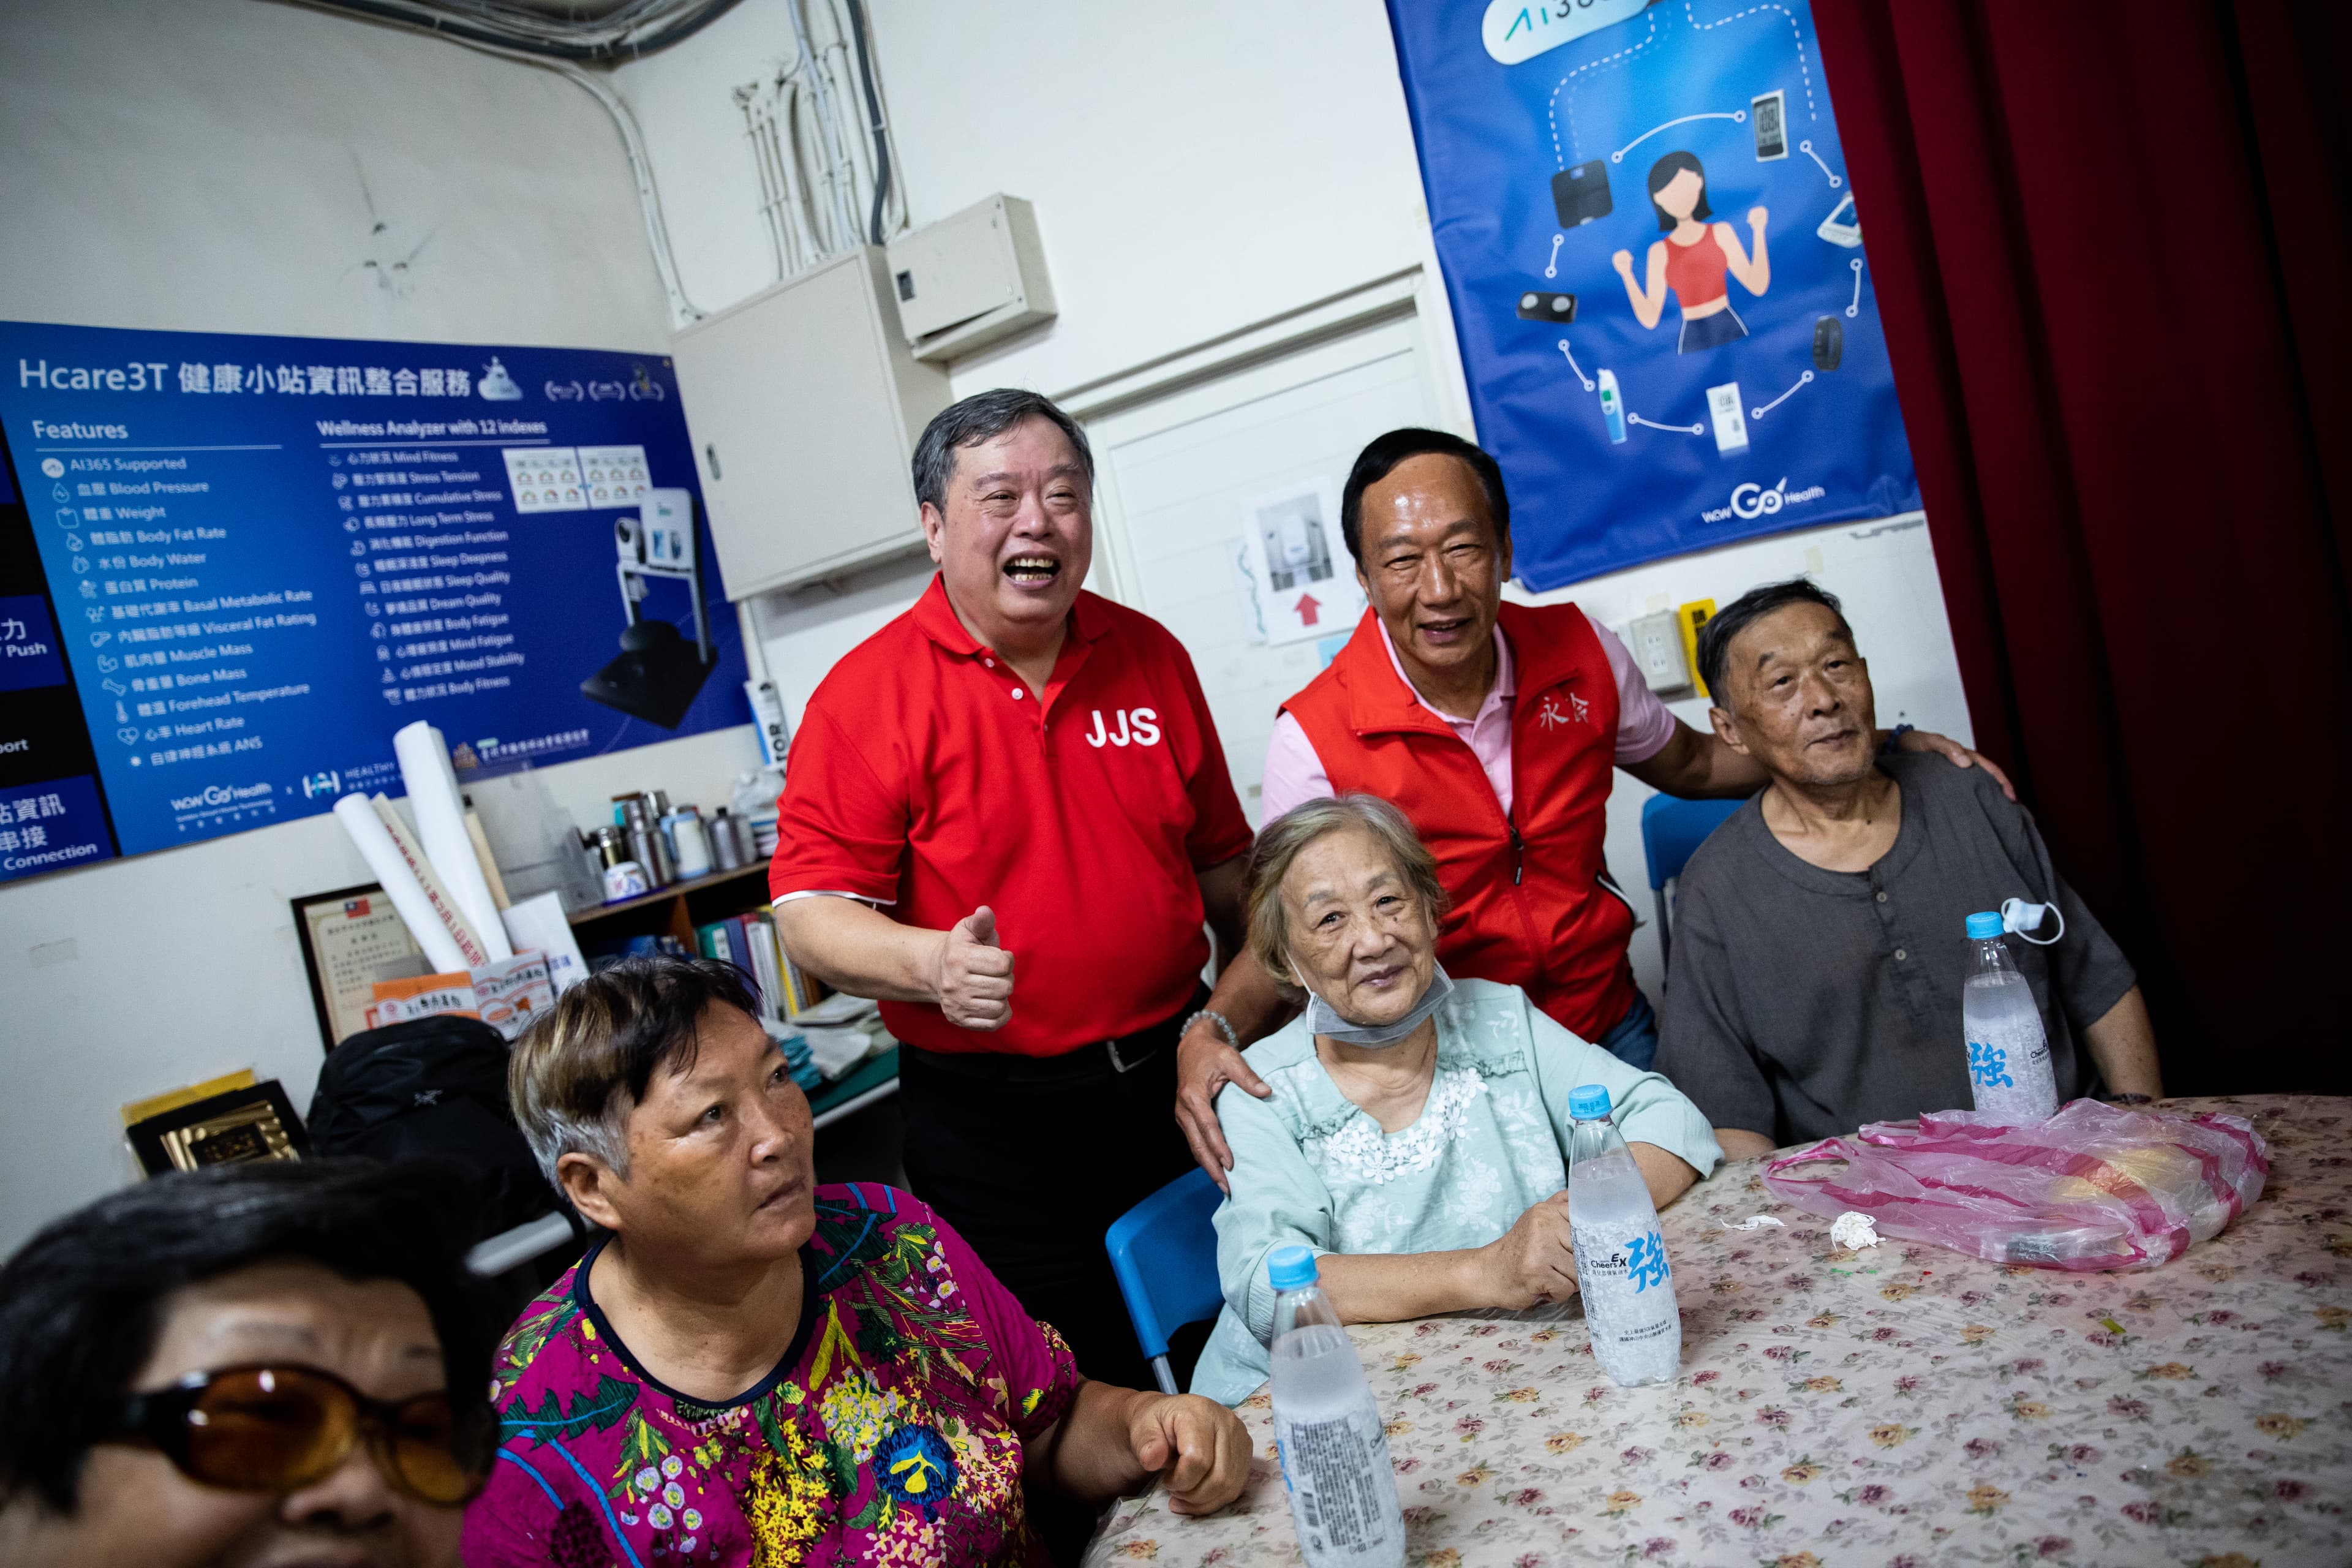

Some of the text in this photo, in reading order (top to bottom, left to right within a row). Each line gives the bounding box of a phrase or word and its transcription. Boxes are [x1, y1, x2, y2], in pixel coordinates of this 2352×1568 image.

[19, 358, 470, 397] Hcare3T 健康小站資訊整合服務
[32, 420, 128, 439] Features
[316, 420, 548, 439] Wellness Analyzer with 12 indexes
[114, 456, 187, 473] Supported
[393, 451, 422, 464] Mind
[422, 450, 459, 463] Fitness
[409, 471, 441, 484] Stress
[440, 470, 480, 483] Tension
[109, 481, 151, 495] Blood
[153, 481, 209, 494] Pressure
[414, 491, 472, 505] Cumulative
[472, 489, 503, 502] Stress
[115, 505, 166, 522] Weight
[409, 514, 437, 528] Long
[436, 511, 464, 525] Term
[463, 510, 494, 524] Stress
[136, 529, 172, 545] Body
[173, 528, 195, 541] Fat
[196, 526, 227, 539] Rate
[414, 533, 464, 549] Digestion
[464, 529, 509, 543] Function
[129, 554, 164, 570] Body
[166, 552, 206, 565] Water
[429, 554, 459, 568] Sleep
[149, 576, 198, 590] Protein
[445, 574, 474, 588] Sleep
[474, 570, 511, 586] Quality
[184, 597, 218, 613] Basal
[219, 592, 284, 609] Metabolic
[284, 589, 313, 603] Rate
[429, 597, 465, 611] Dream
[464, 592, 502, 608] Quality
[0, 617, 27, 641] 力
[202, 617, 254, 635] Visceral
[254, 614, 275, 629] Fat
[276, 612, 317, 627] Rating
[445, 616, 472, 631] Body
[472, 613, 509, 628] Fatigue
[6, 642, 48, 658] Push
[449, 636, 477, 652] Mind
[477, 633, 514, 648] Fatigue
[169, 646, 217, 663] Muscle
[218, 643, 254, 657] Mass
[453, 656, 485, 672] Mood
[485, 652, 525, 668] Stability
[176, 673, 211, 687] Bone
[213, 668, 247, 682] Mass
[448, 679, 475, 695] Body
[168, 692, 231, 712] Forehead
[232, 683, 311, 703] Temperature
[175, 721, 214, 736] Heart
[214, 717, 245, 730] Rate
[1085, 707, 1161, 748] JJS
[234, 736, 263, 752] ANS
[3, 842, 98, 870] Connection
[1969, 1042, 2013, 1088] 強
[1591, 1260, 1617, 1269] Cheers
[1624, 1231, 1670, 1294] 強
